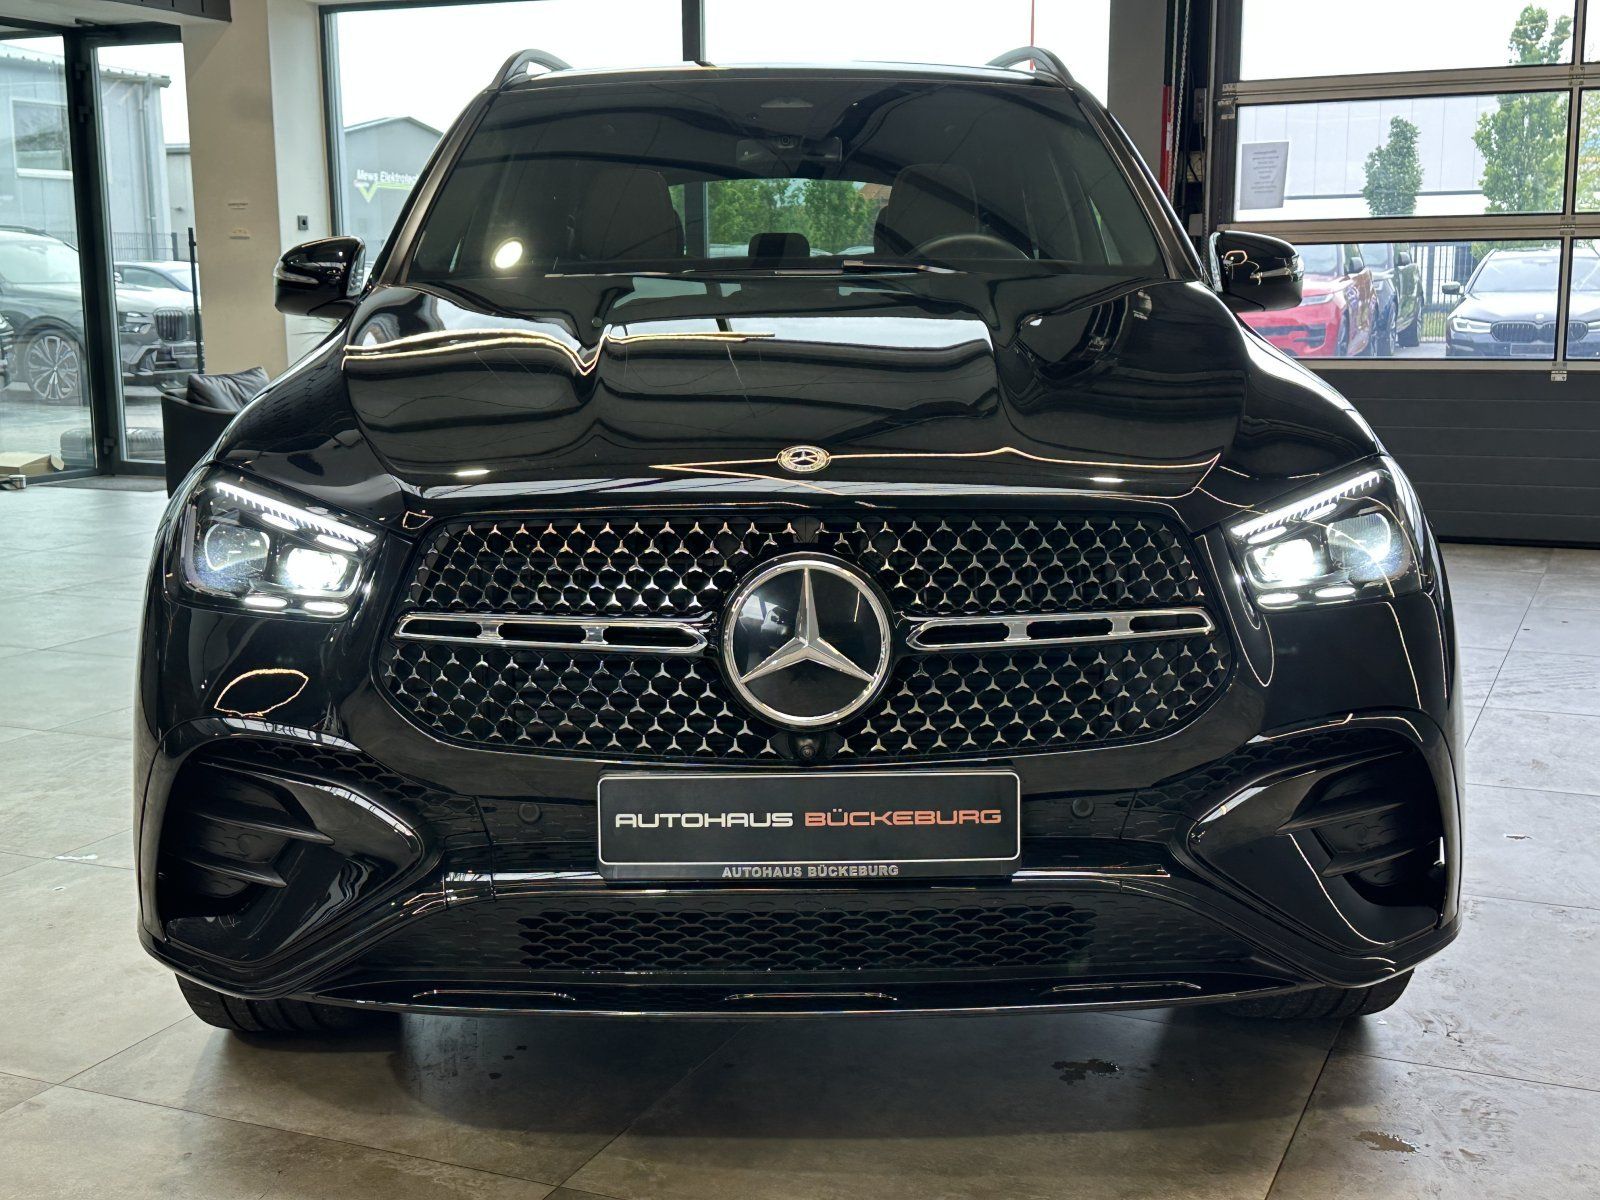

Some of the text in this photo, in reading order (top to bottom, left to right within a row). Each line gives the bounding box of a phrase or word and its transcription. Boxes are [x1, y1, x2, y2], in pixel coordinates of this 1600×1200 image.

[615, 808, 1002, 828] AUTOHAUS BÜCKEBURG
[721, 865, 899, 878] AUTOHAUS BÜCKEBURG
